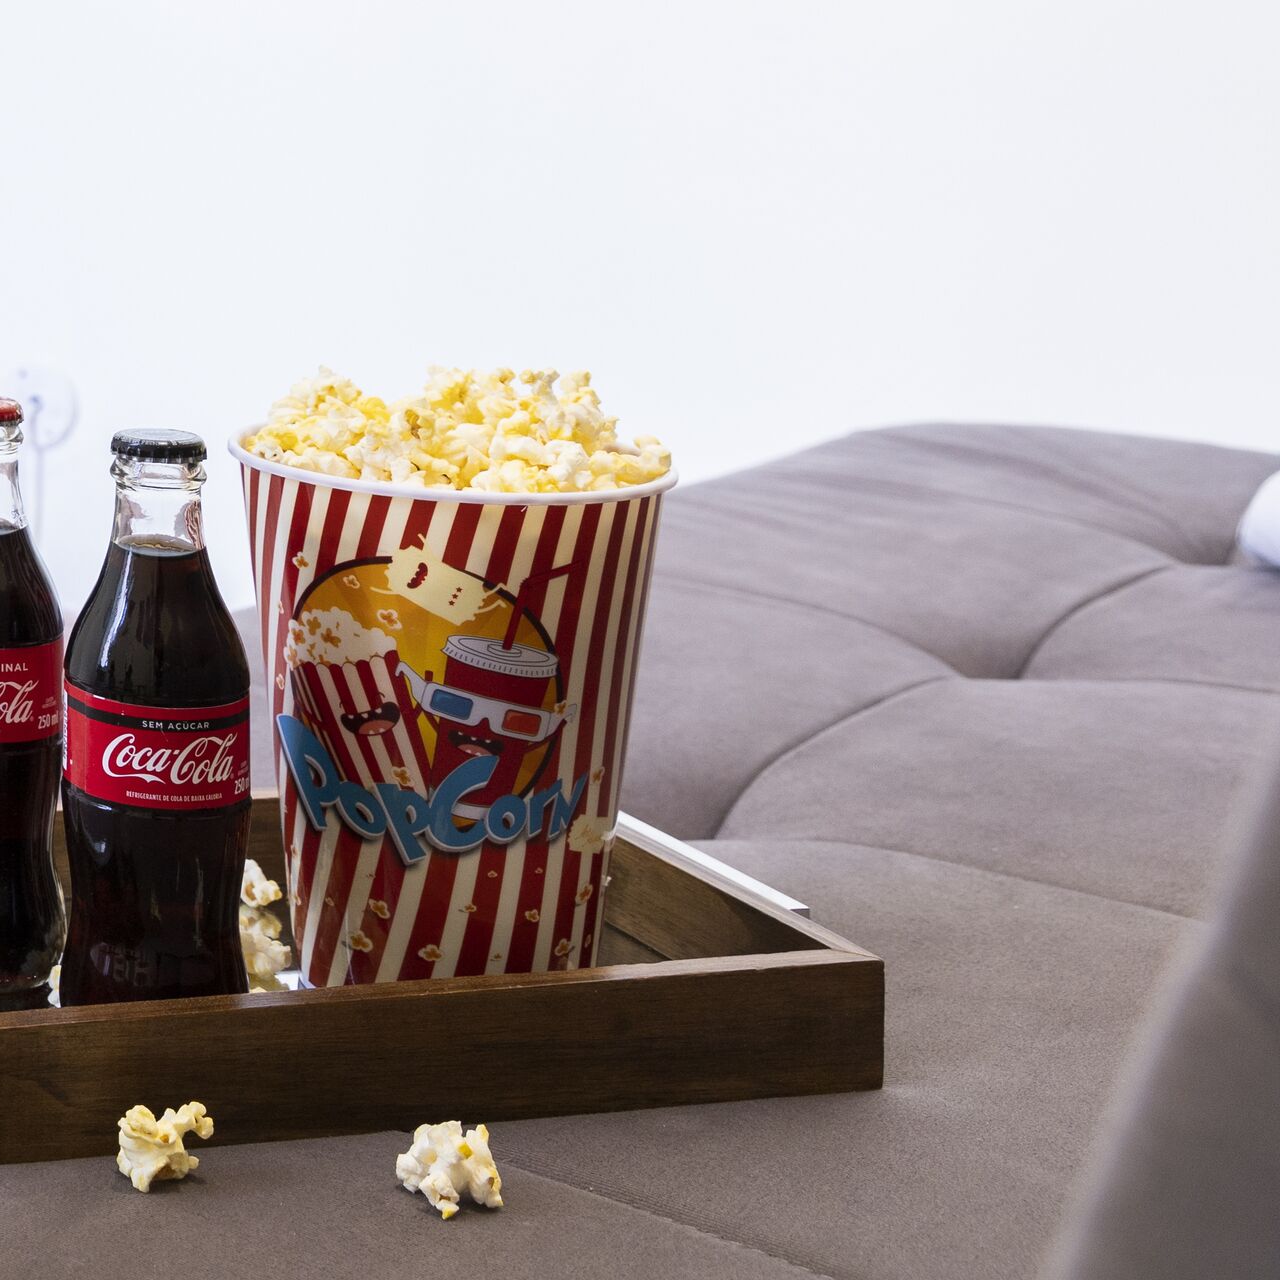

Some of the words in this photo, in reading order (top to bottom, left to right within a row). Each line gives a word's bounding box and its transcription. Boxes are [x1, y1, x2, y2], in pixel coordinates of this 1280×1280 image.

[38, 713, 51, 729] 250
[142, 720, 163, 729] SEM
[102, 733, 238, 785] Coca-Cola
[234, 777, 246, 795] 250
[126, 790, 162, 801] REFRIGERANTE
[191, 794, 206, 802] BAIXA
[205, 792, 223, 801] CALORIA
